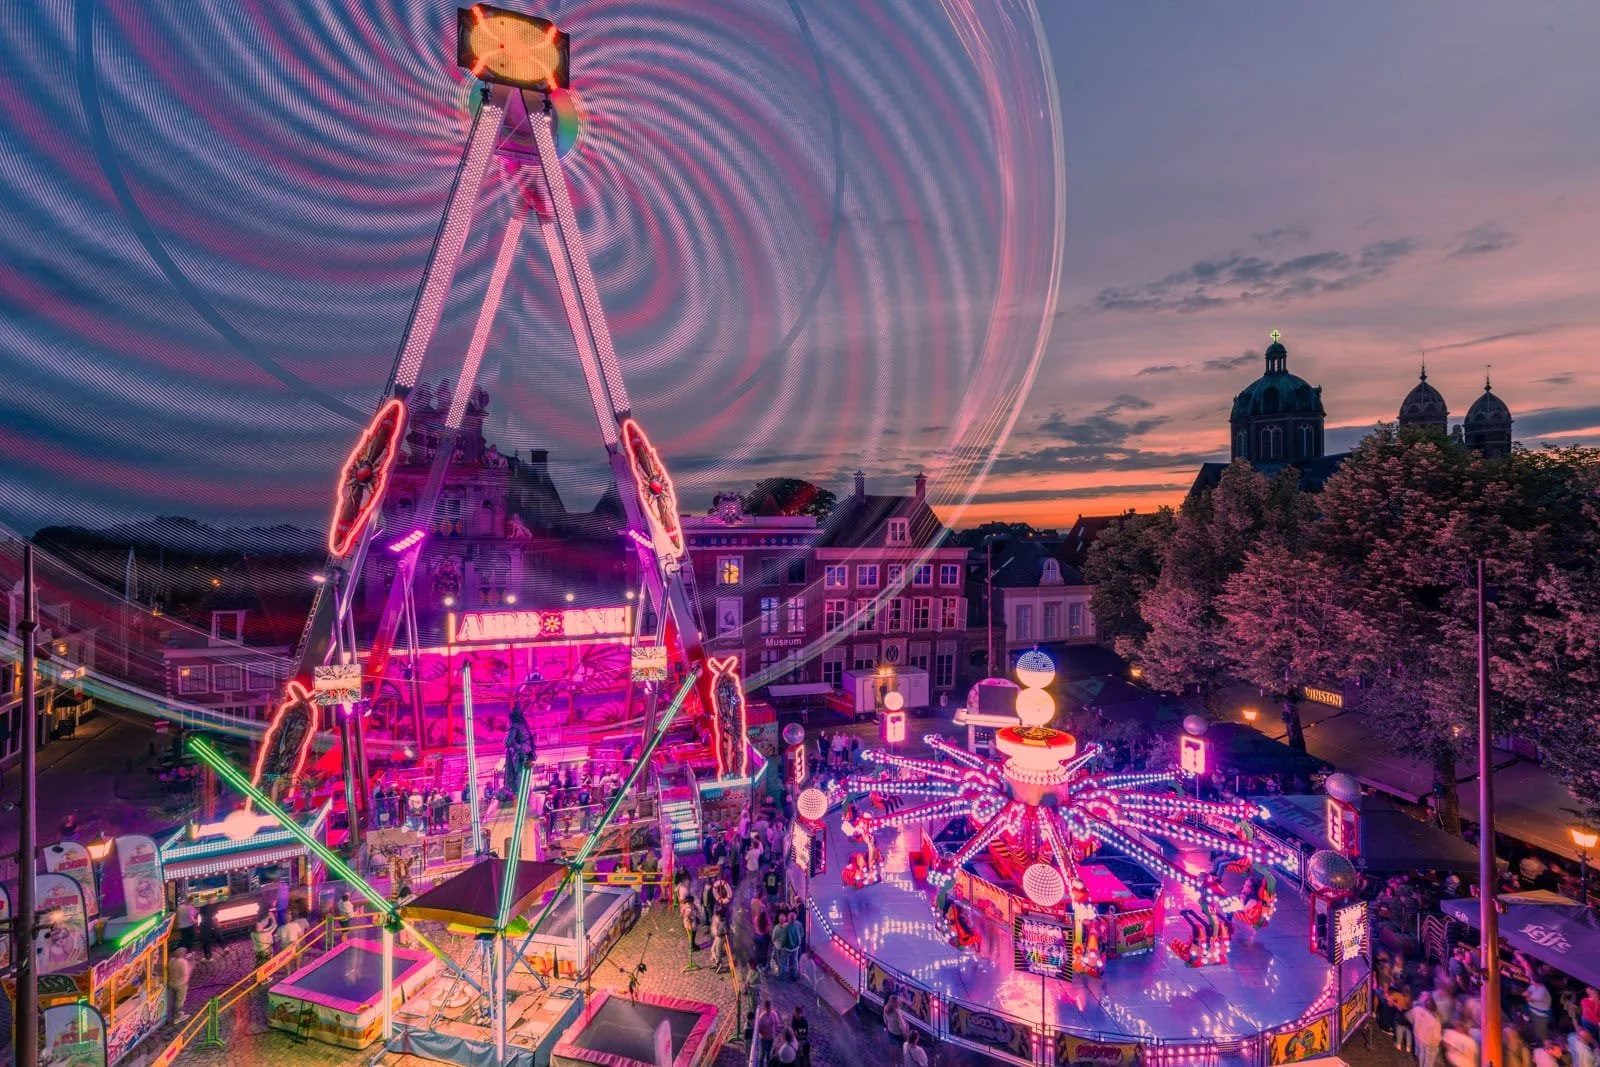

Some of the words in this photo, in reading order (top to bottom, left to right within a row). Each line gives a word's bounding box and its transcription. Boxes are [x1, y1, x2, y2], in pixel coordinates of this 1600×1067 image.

[765, 638, 802, 647] Museum
[1304, 686, 1342, 708] WINSTON
[1519, 923, 1571, 951] Leffe
